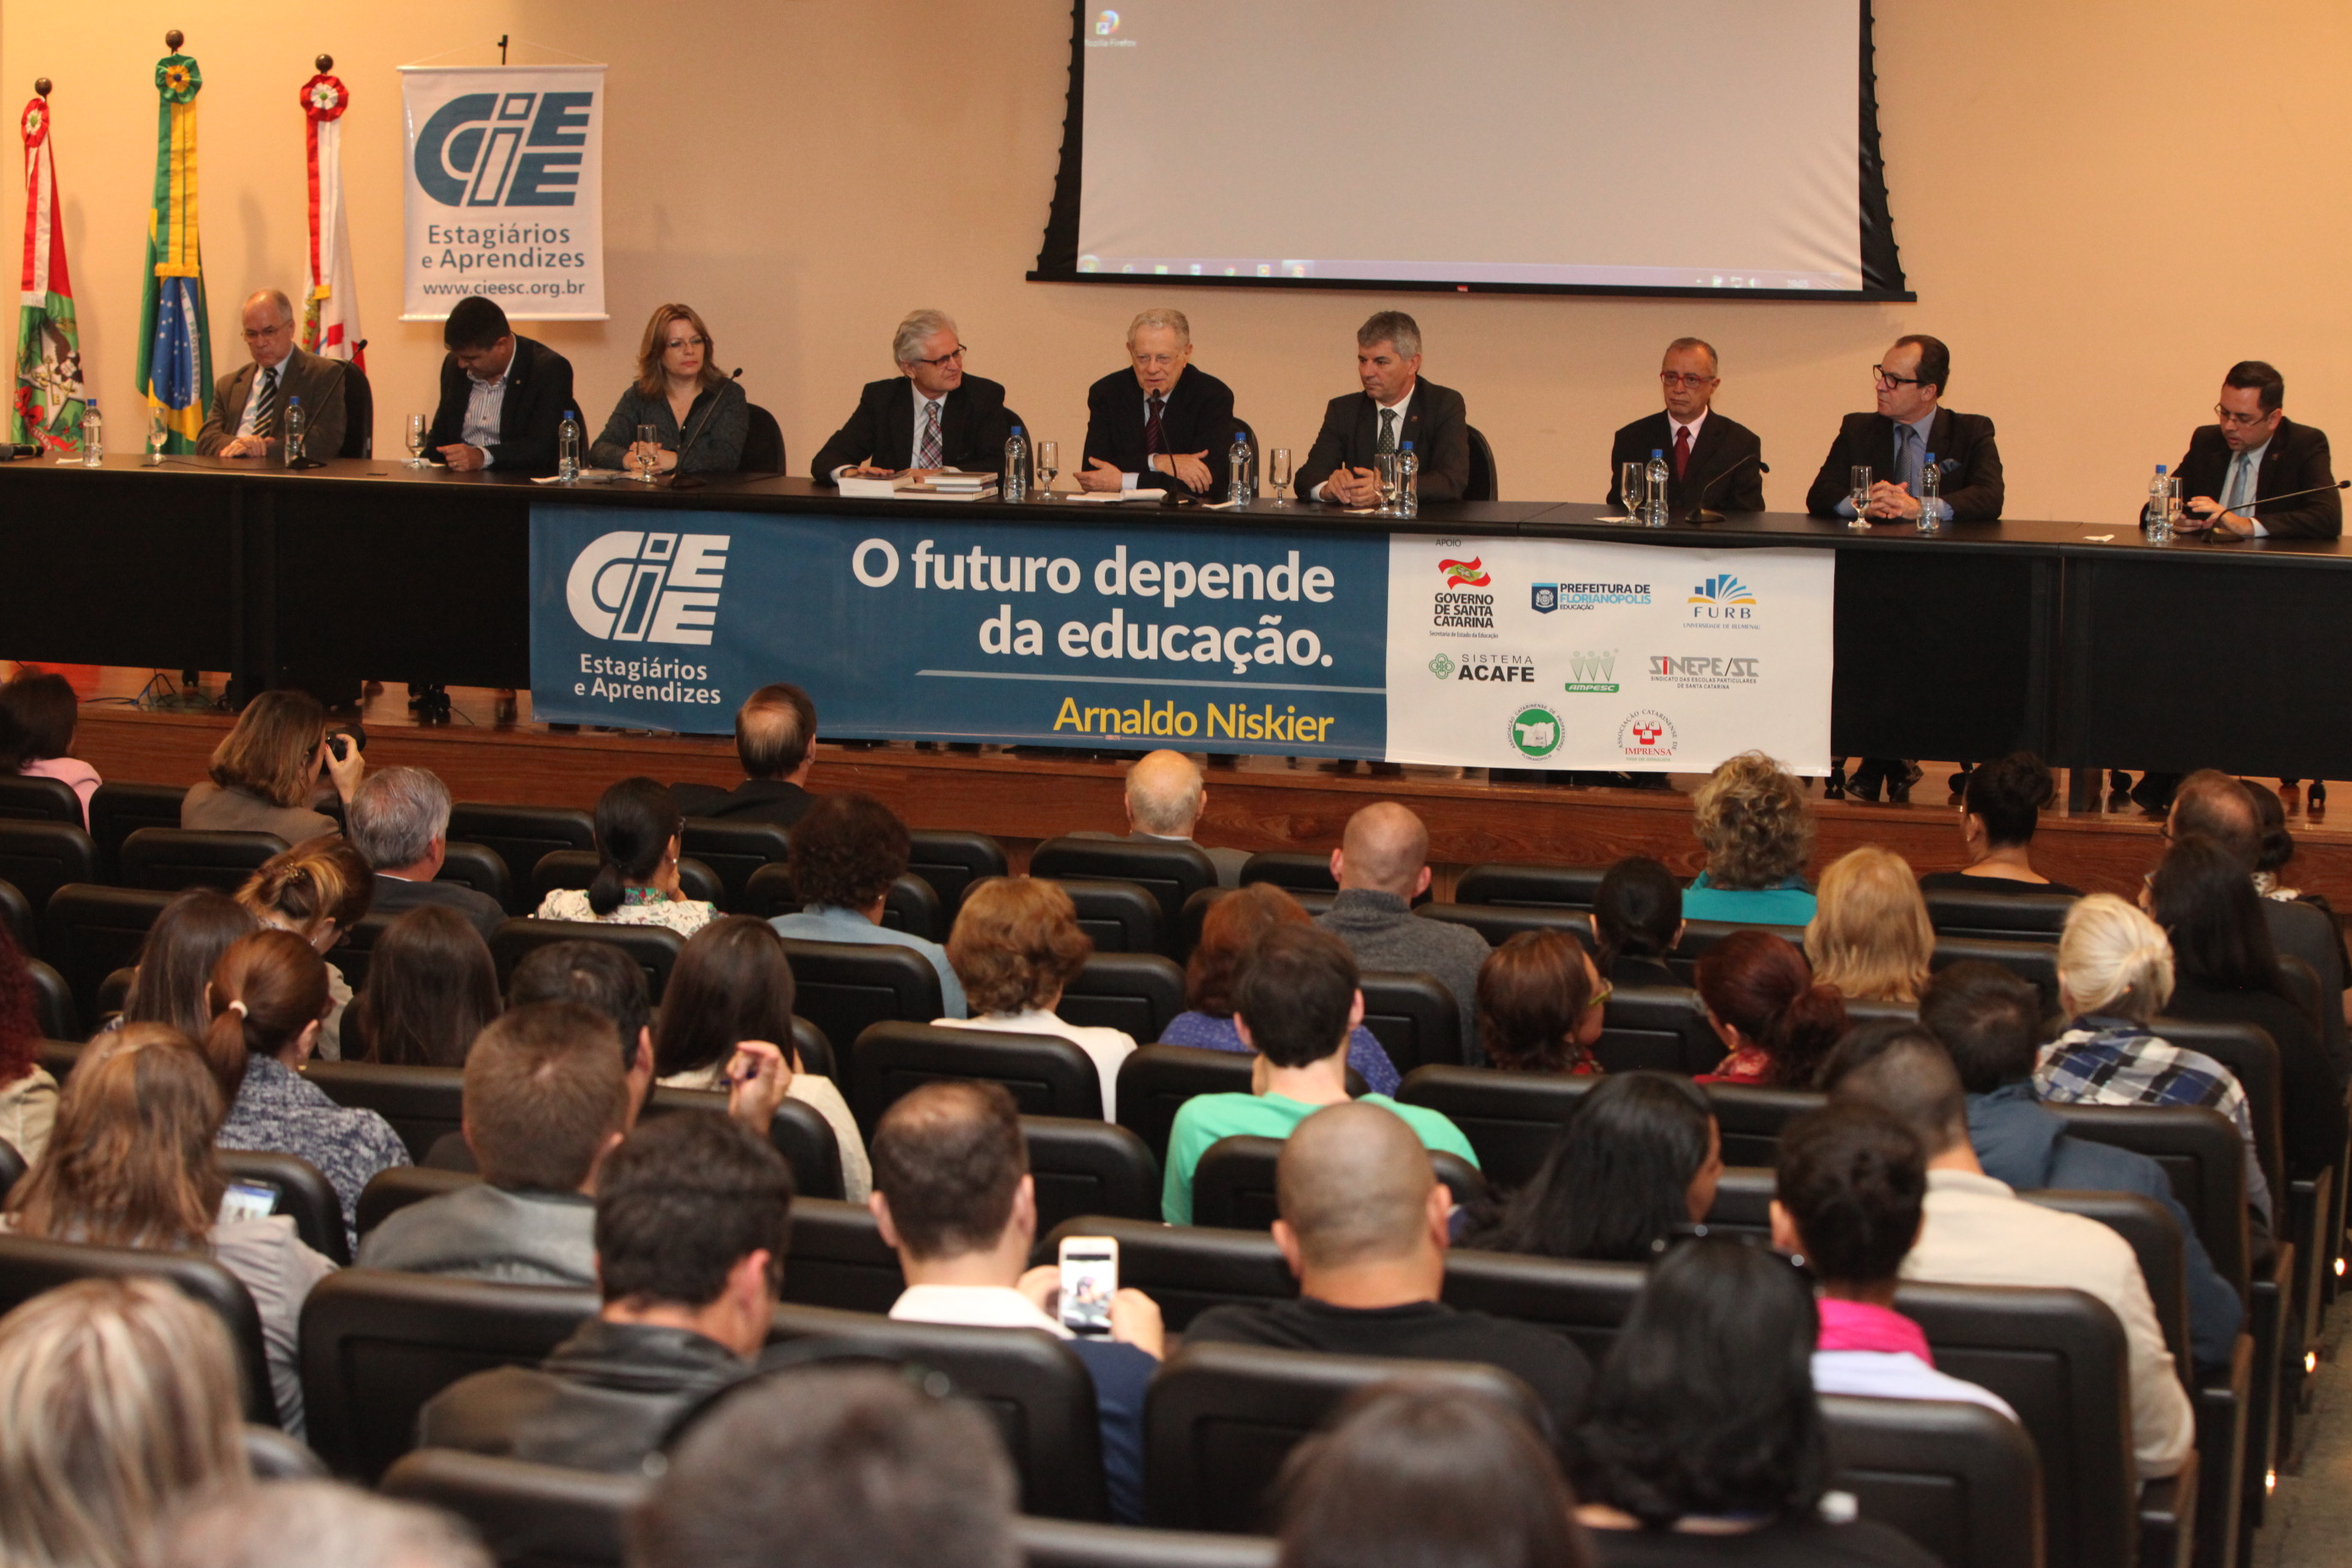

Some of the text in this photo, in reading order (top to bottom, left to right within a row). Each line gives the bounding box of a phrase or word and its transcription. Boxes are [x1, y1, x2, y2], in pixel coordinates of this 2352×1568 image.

[1085, 38, 1108, 47] ozilla
[428, 223, 569, 248] Estagiários
[422, 247, 585, 273] e Aprendizes
[422, 280, 585, 297] www.cieesc.org.br
[1435, 538, 1462, 547] APOIO
[852, 538, 1335, 607] O futuro depende
[1560, 583, 1651, 594] PREFEITURA DE
[1435, 592, 1494, 605] GOVERNO
[1560, 593, 1652, 605] FLORIANÓPOLIS
[1435, 604, 1493, 617] DE SANTA
[1694, 607, 1751, 618] FURB
[1434, 616, 1494, 628] CATARINA
[978, 604, 1334, 674] da educação.
[1462, 654, 1533, 664] SISTEMA
[580, 653, 708, 682] Estagiários
[1458, 665, 1535, 683] ACAFE
[574, 678, 721, 705] e Aprendizes
[1053, 697, 1335, 742] Arnaldo Niskier
[1642, 709, 1678, 738] CATARINENSE
[1625, 748, 1673, 756] IMPRENSA
